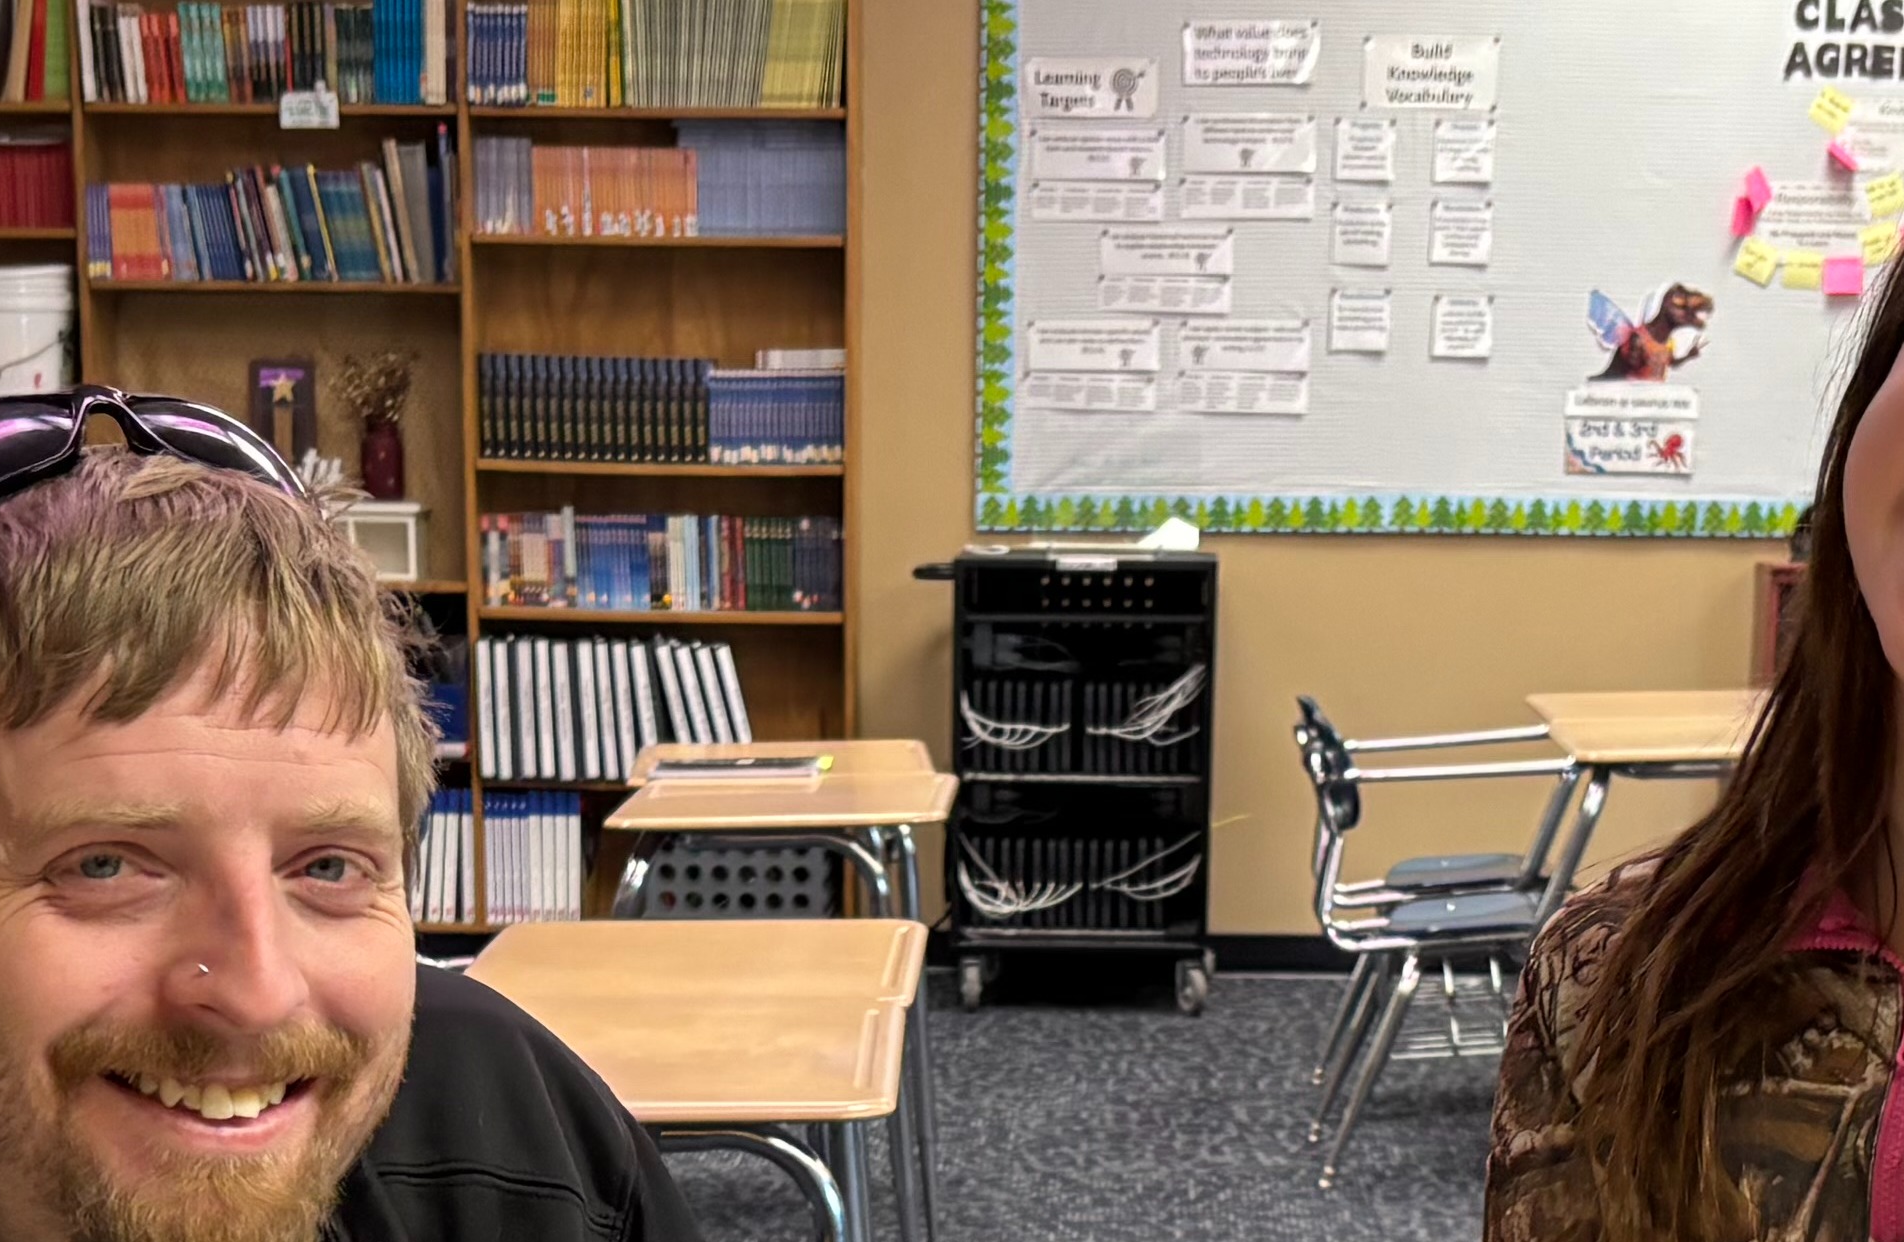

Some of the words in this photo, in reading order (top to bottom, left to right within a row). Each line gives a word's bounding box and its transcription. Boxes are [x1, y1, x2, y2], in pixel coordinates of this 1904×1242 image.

[1410, 43, 1454, 60] Build
[1033, 69, 1102, 93] Learning
[1386, 66, 1474, 87] Knowledge
[1039, 92, 1096, 111] Targets
[1385, 87, 1474, 110] Vocabulary
[1579, 422, 1611, 438] 2nd
[1612, 421, 1626, 438] &
[1628, 421, 1659, 438] 3rd
[1588, 445, 1643, 462] Period
